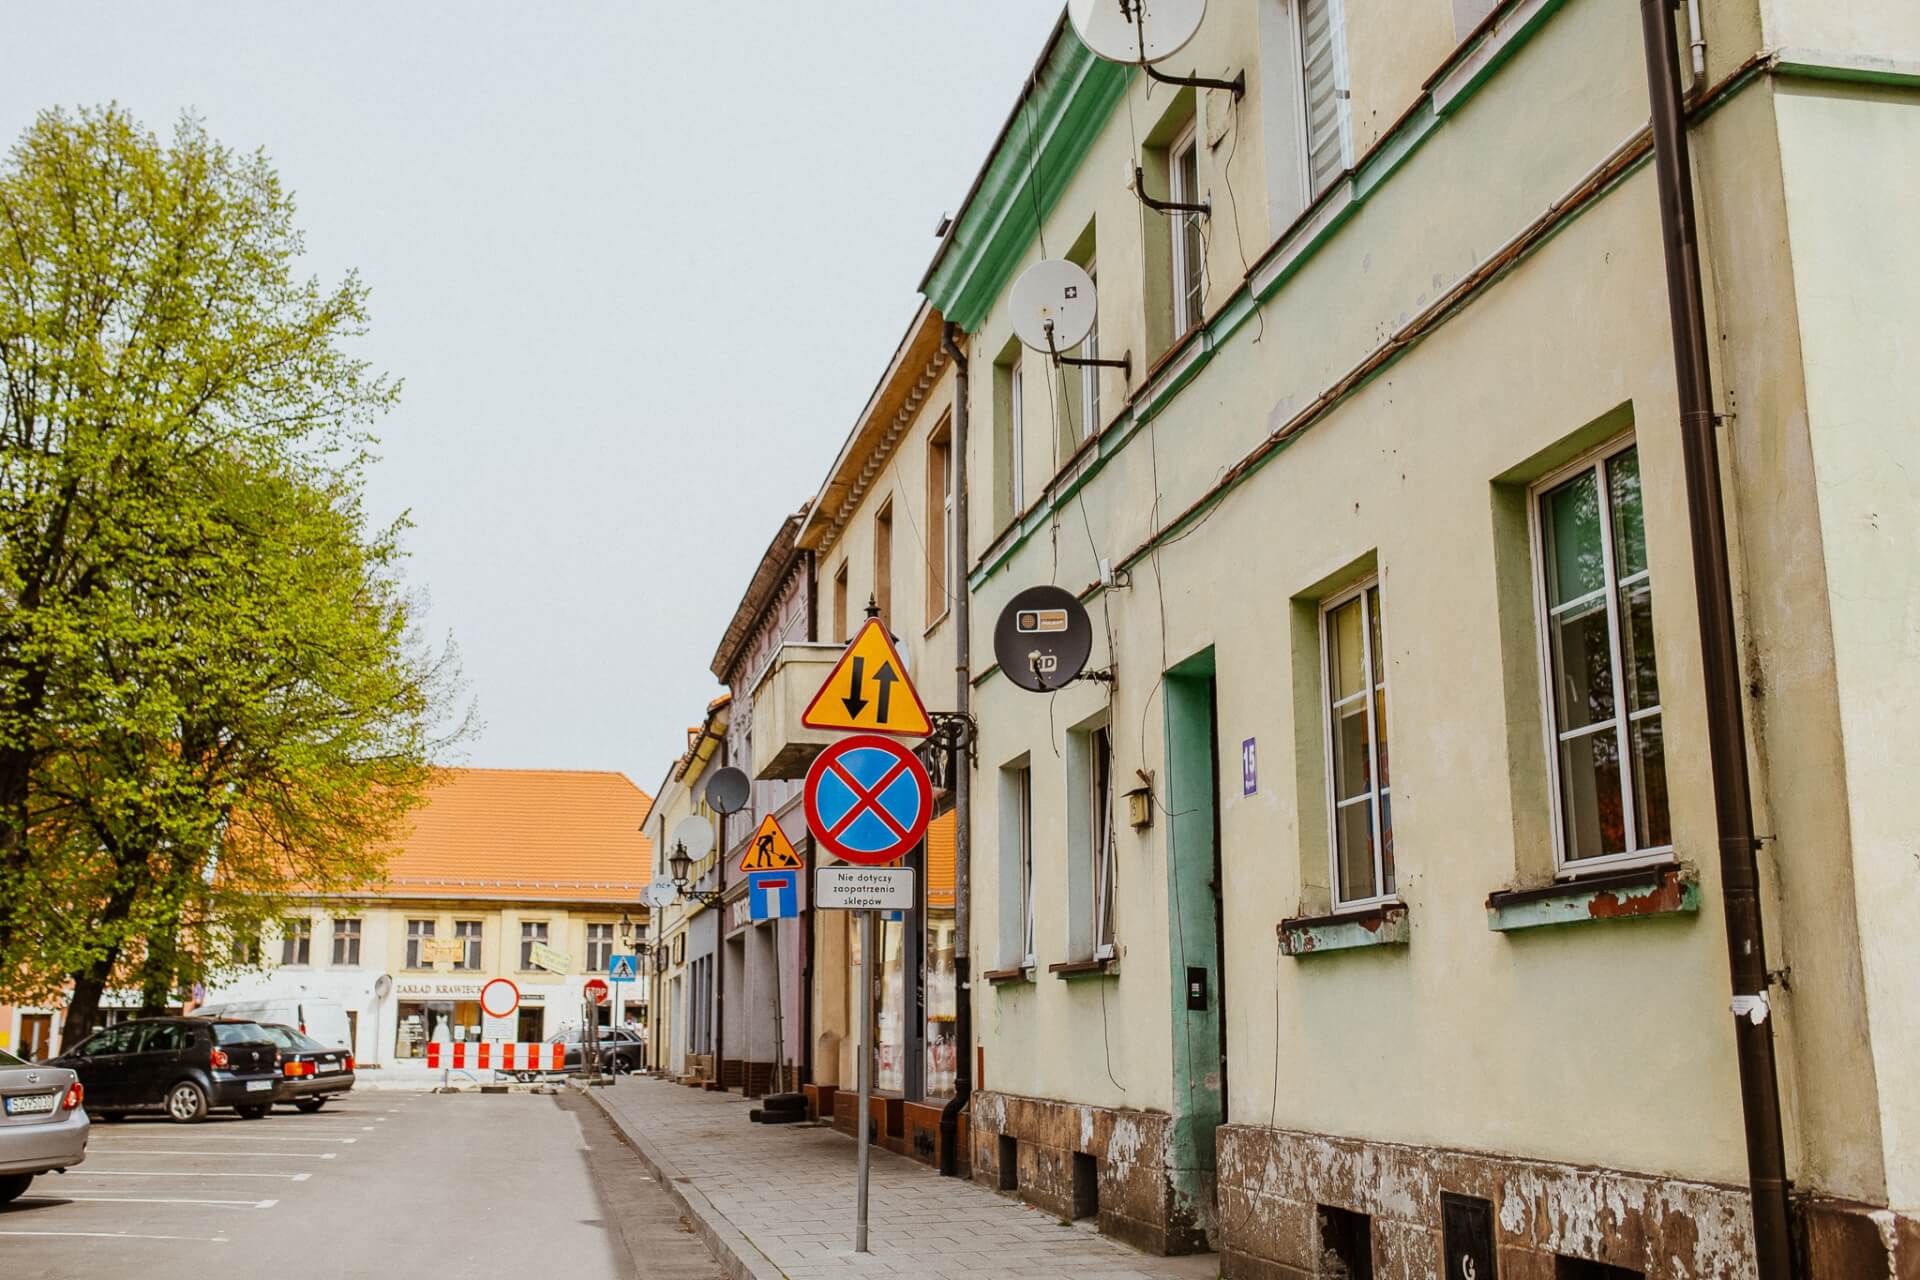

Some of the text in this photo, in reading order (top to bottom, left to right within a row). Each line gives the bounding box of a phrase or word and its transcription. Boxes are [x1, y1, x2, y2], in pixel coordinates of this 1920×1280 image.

[1243, 744, 1255, 774] 15
[838, 873, 892, 884] Nie dotyczy
[833, 885, 895, 895] zaopatrzenia
[844, 896, 882, 906] sklepów
[396, 984, 482, 994] ZAKŁAD KRAWIECK
